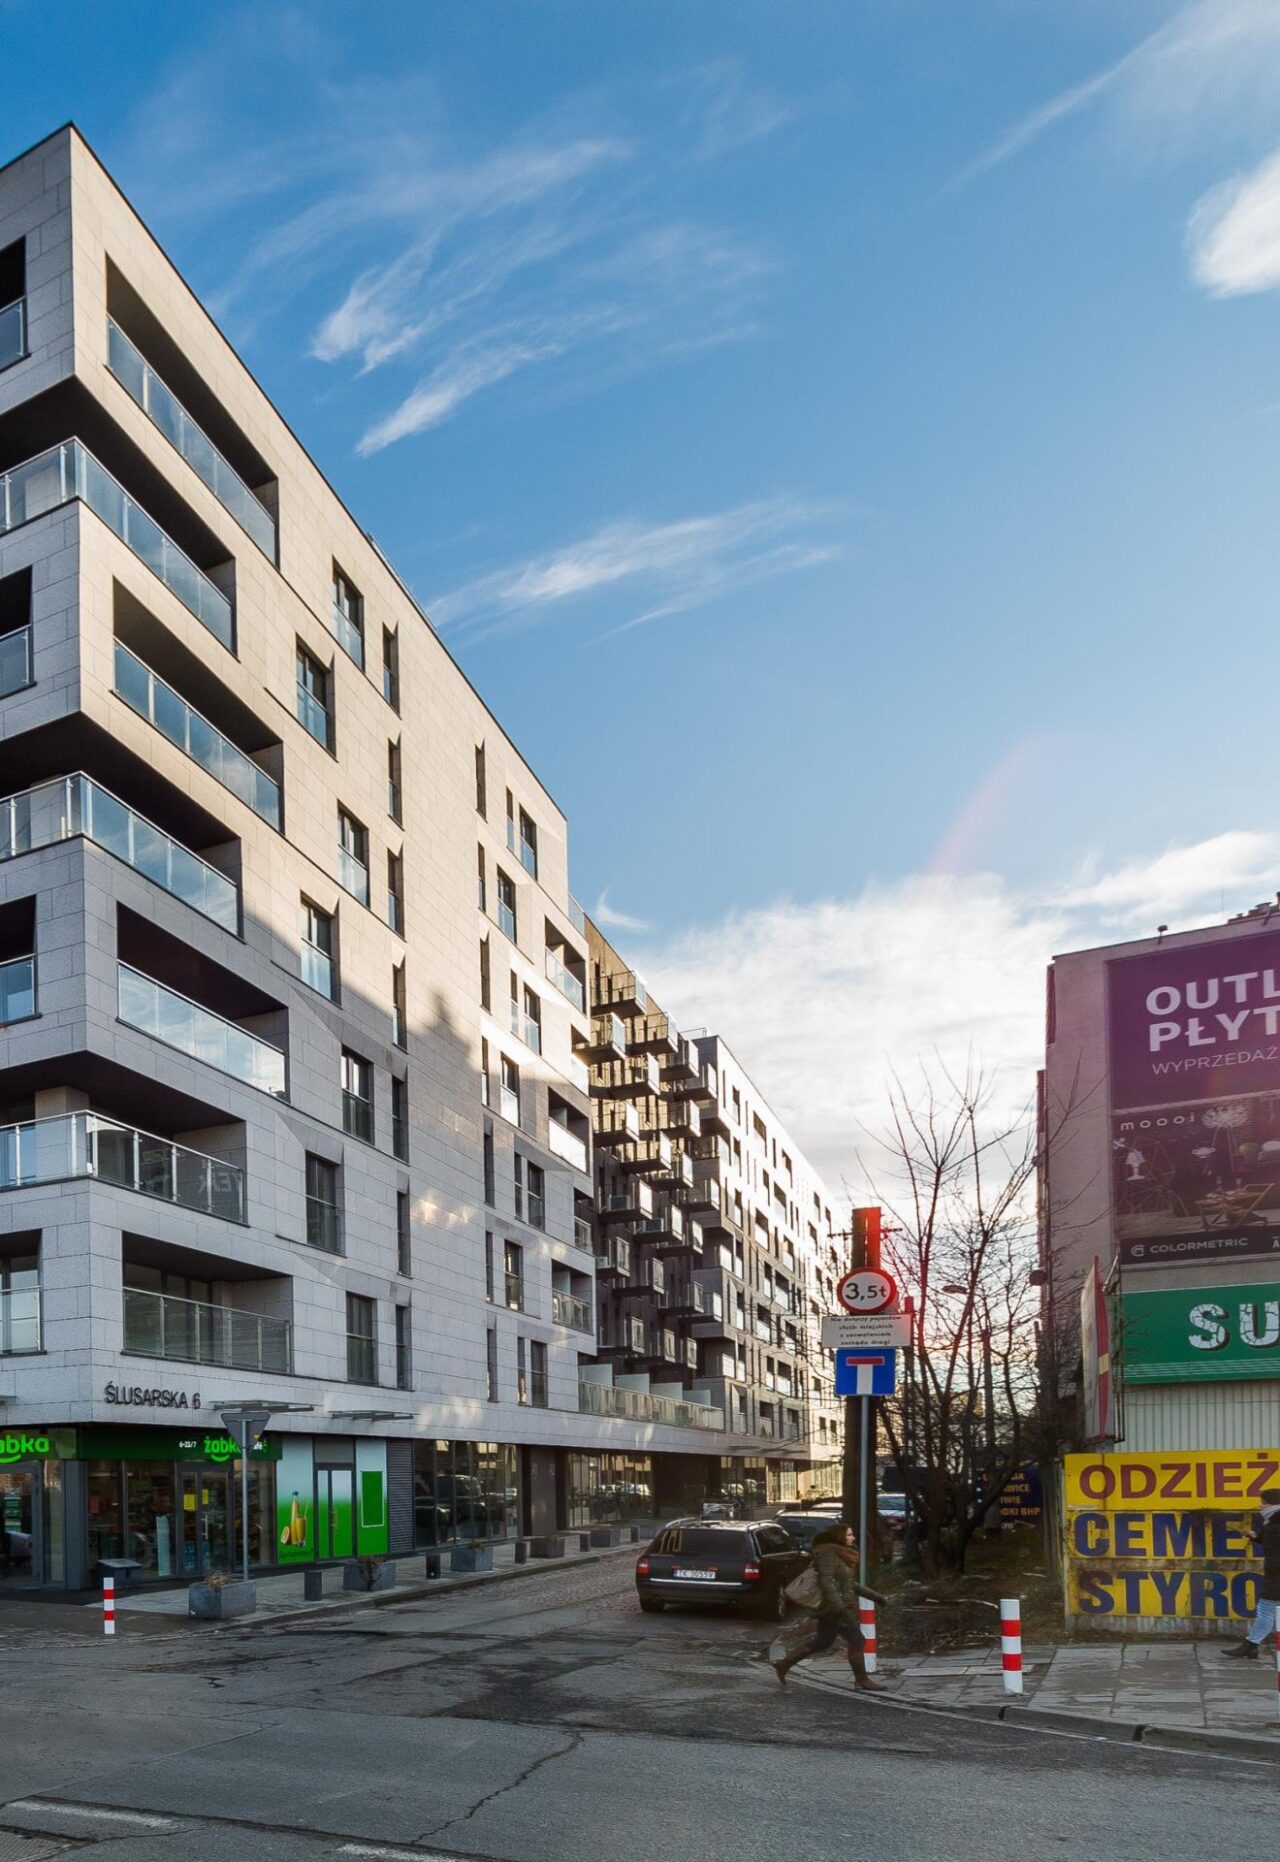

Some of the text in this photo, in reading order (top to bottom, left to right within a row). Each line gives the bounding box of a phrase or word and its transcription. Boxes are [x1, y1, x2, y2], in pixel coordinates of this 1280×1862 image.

[1145, 968, 1280, 1017] OUTL
[1149, 1005, 1280, 1052] PŁYT
[1120, 1111, 1195, 1131] moooi
[1149, 1237, 1249, 1254] COLORMETRIC
[1188, 1300, 1280, 1350] SU
[104, 1380, 201, 1410] ŚLUSARSKA 6
[204, 1435, 241, 1454] żabk
[1079, 1453, 1280, 1500] ODZIEŻ
